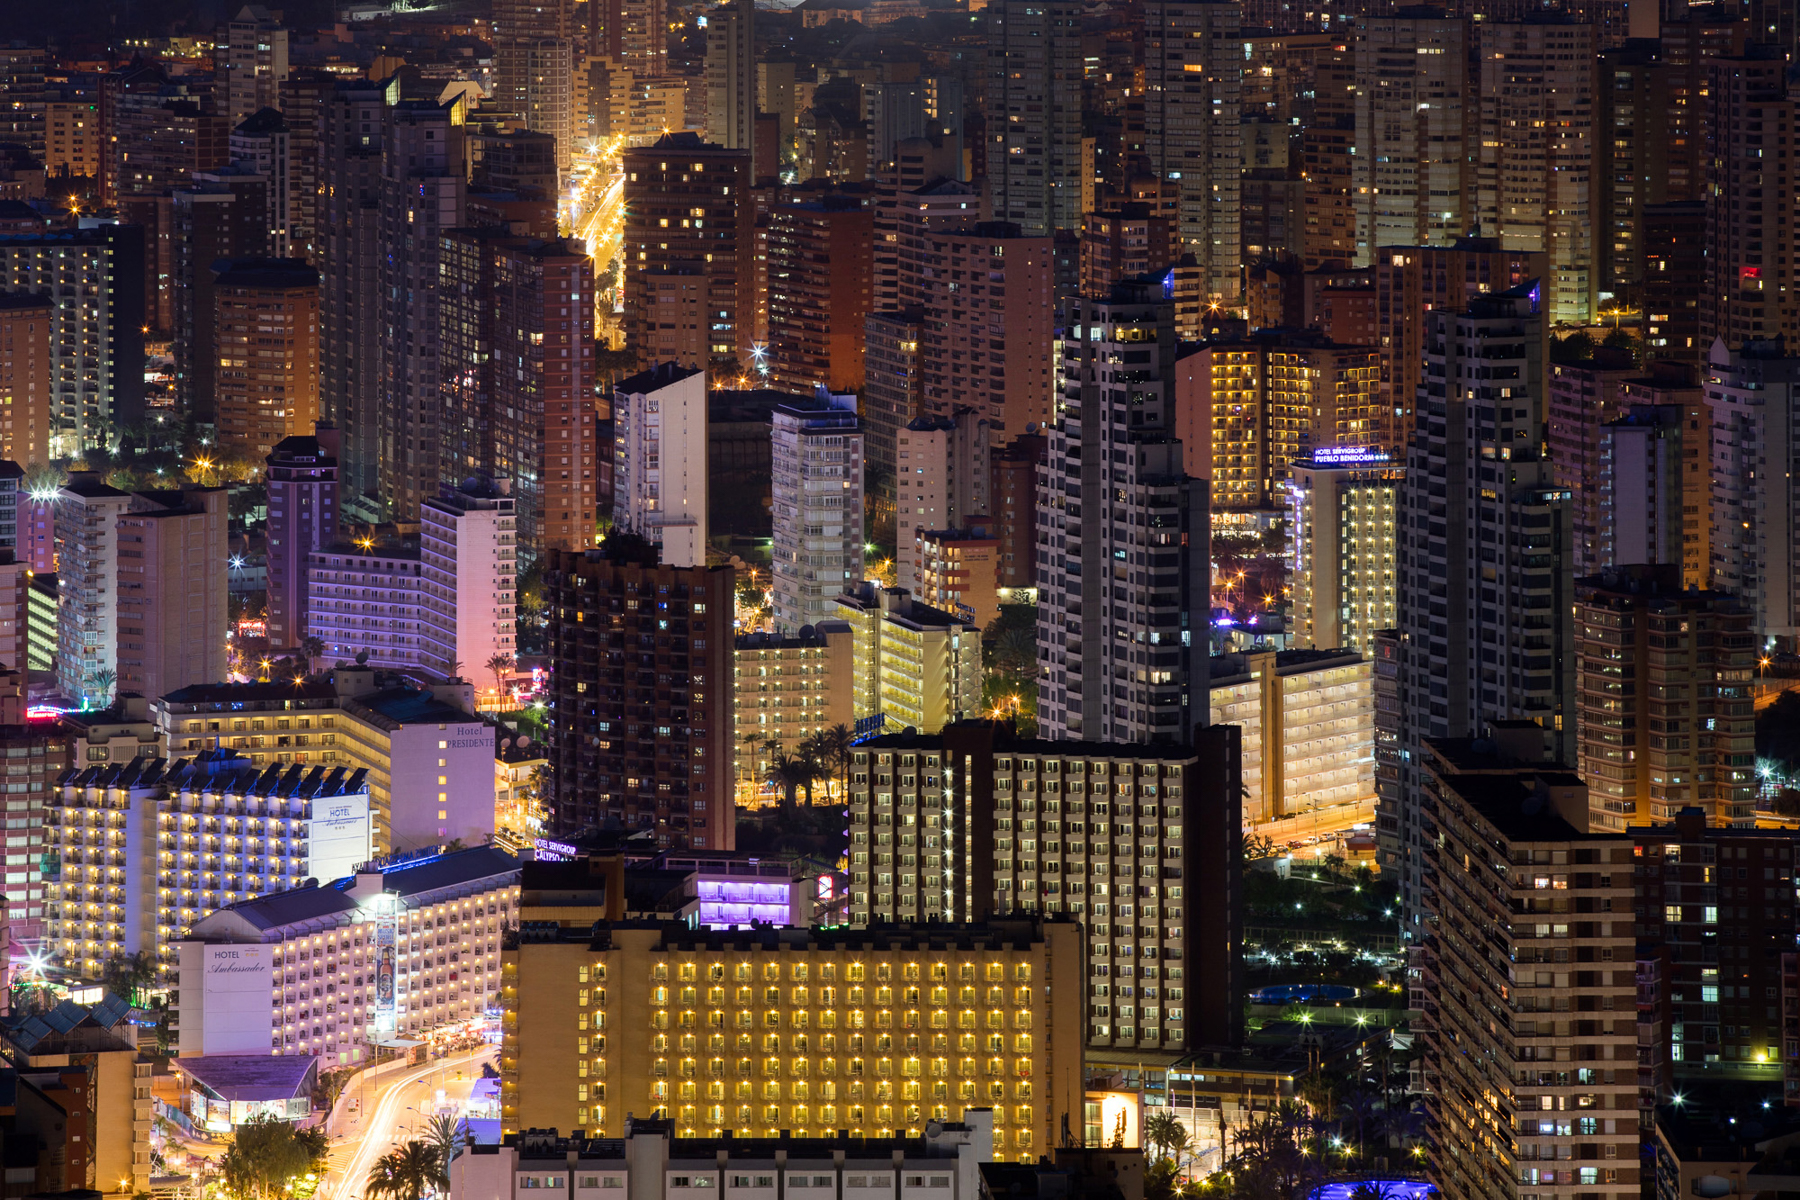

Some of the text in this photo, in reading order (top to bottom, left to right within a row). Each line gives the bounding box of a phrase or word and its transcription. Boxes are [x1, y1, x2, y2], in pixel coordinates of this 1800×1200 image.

[1332, 447, 1366, 455] SERVIGROUP
[1315, 454, 1375, 463] PUEBLO BENIDORM
[1255, 634, 1263, 643] 4
[457, 726, 483, 736] Hotel
[447, 737, 495, 749] PRESIDENTE
[329, 808, 350, 817] HOTEL
[534, 837, 577, 855] HOTEL SERVIGROUP
[534, 848, 560, 862] CALYPSO
[214, 951, 241, 959] HOTEL
[207, 961, 266, 974] Ambassador
